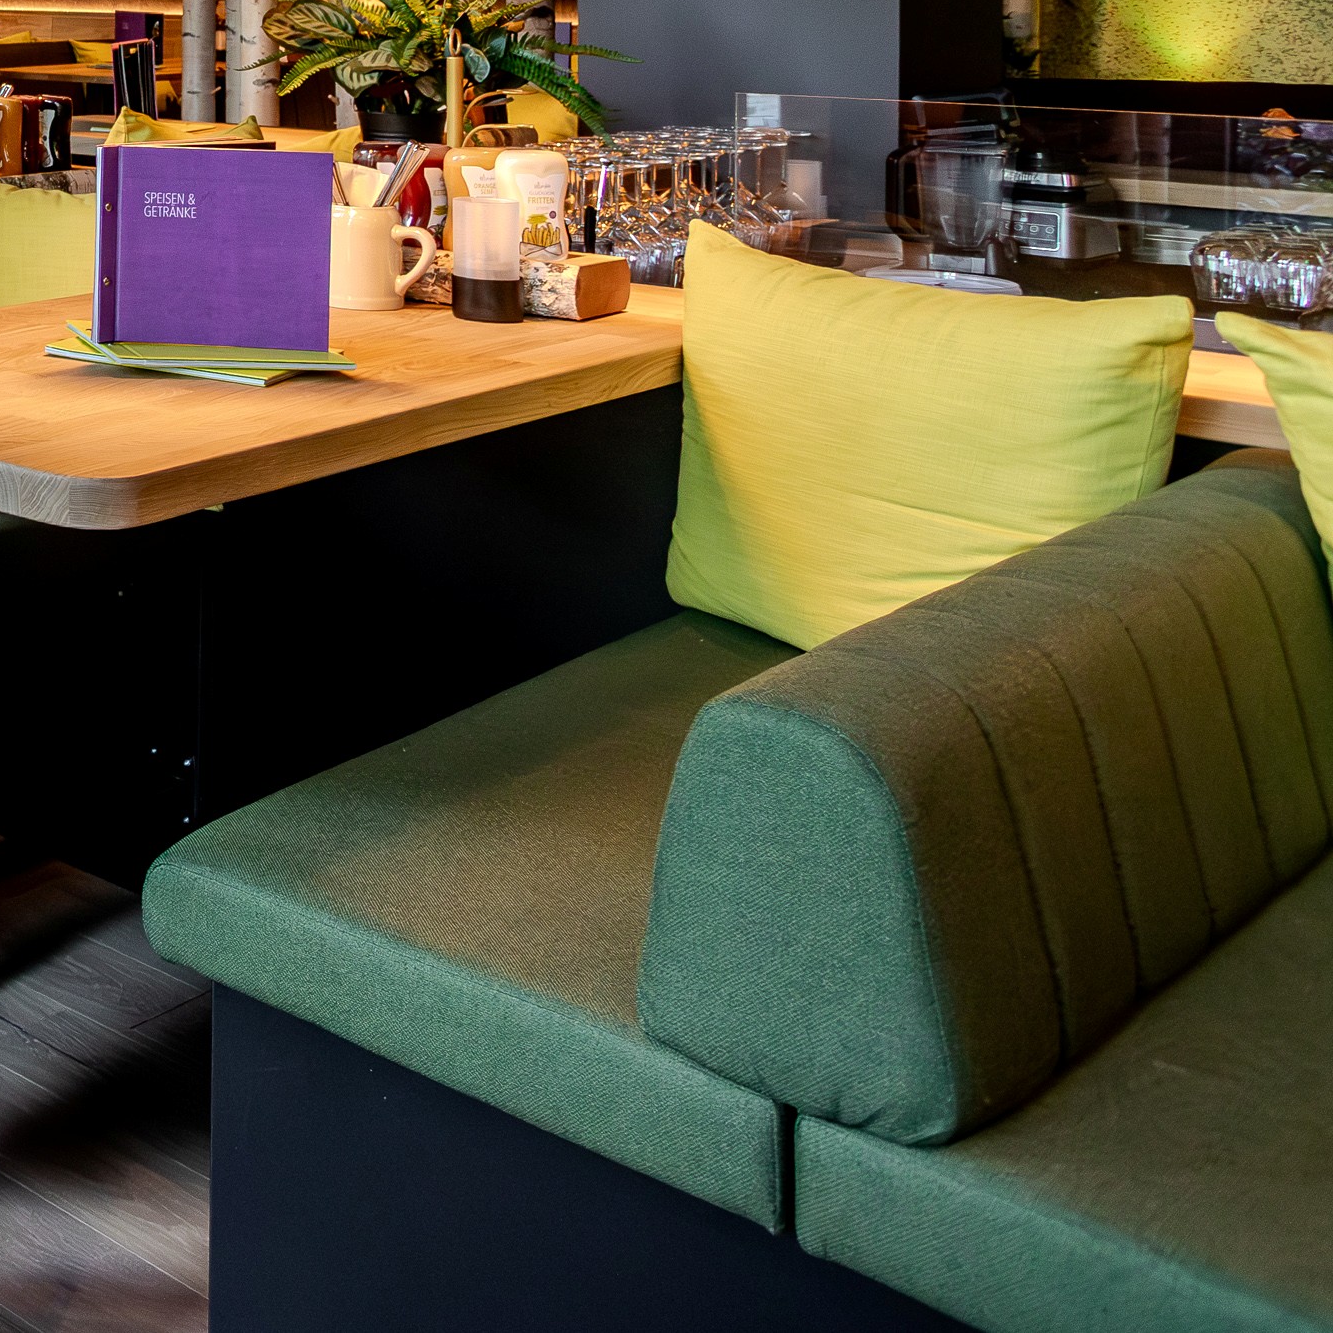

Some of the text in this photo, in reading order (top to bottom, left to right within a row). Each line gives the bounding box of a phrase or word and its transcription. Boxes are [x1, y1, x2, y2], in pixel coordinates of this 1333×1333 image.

[144, 191, 196, 205] SPEISEN &
[527, 196, 555, 204] FRITTEN
[143, 203, 197, 219] GETRÄNKE
